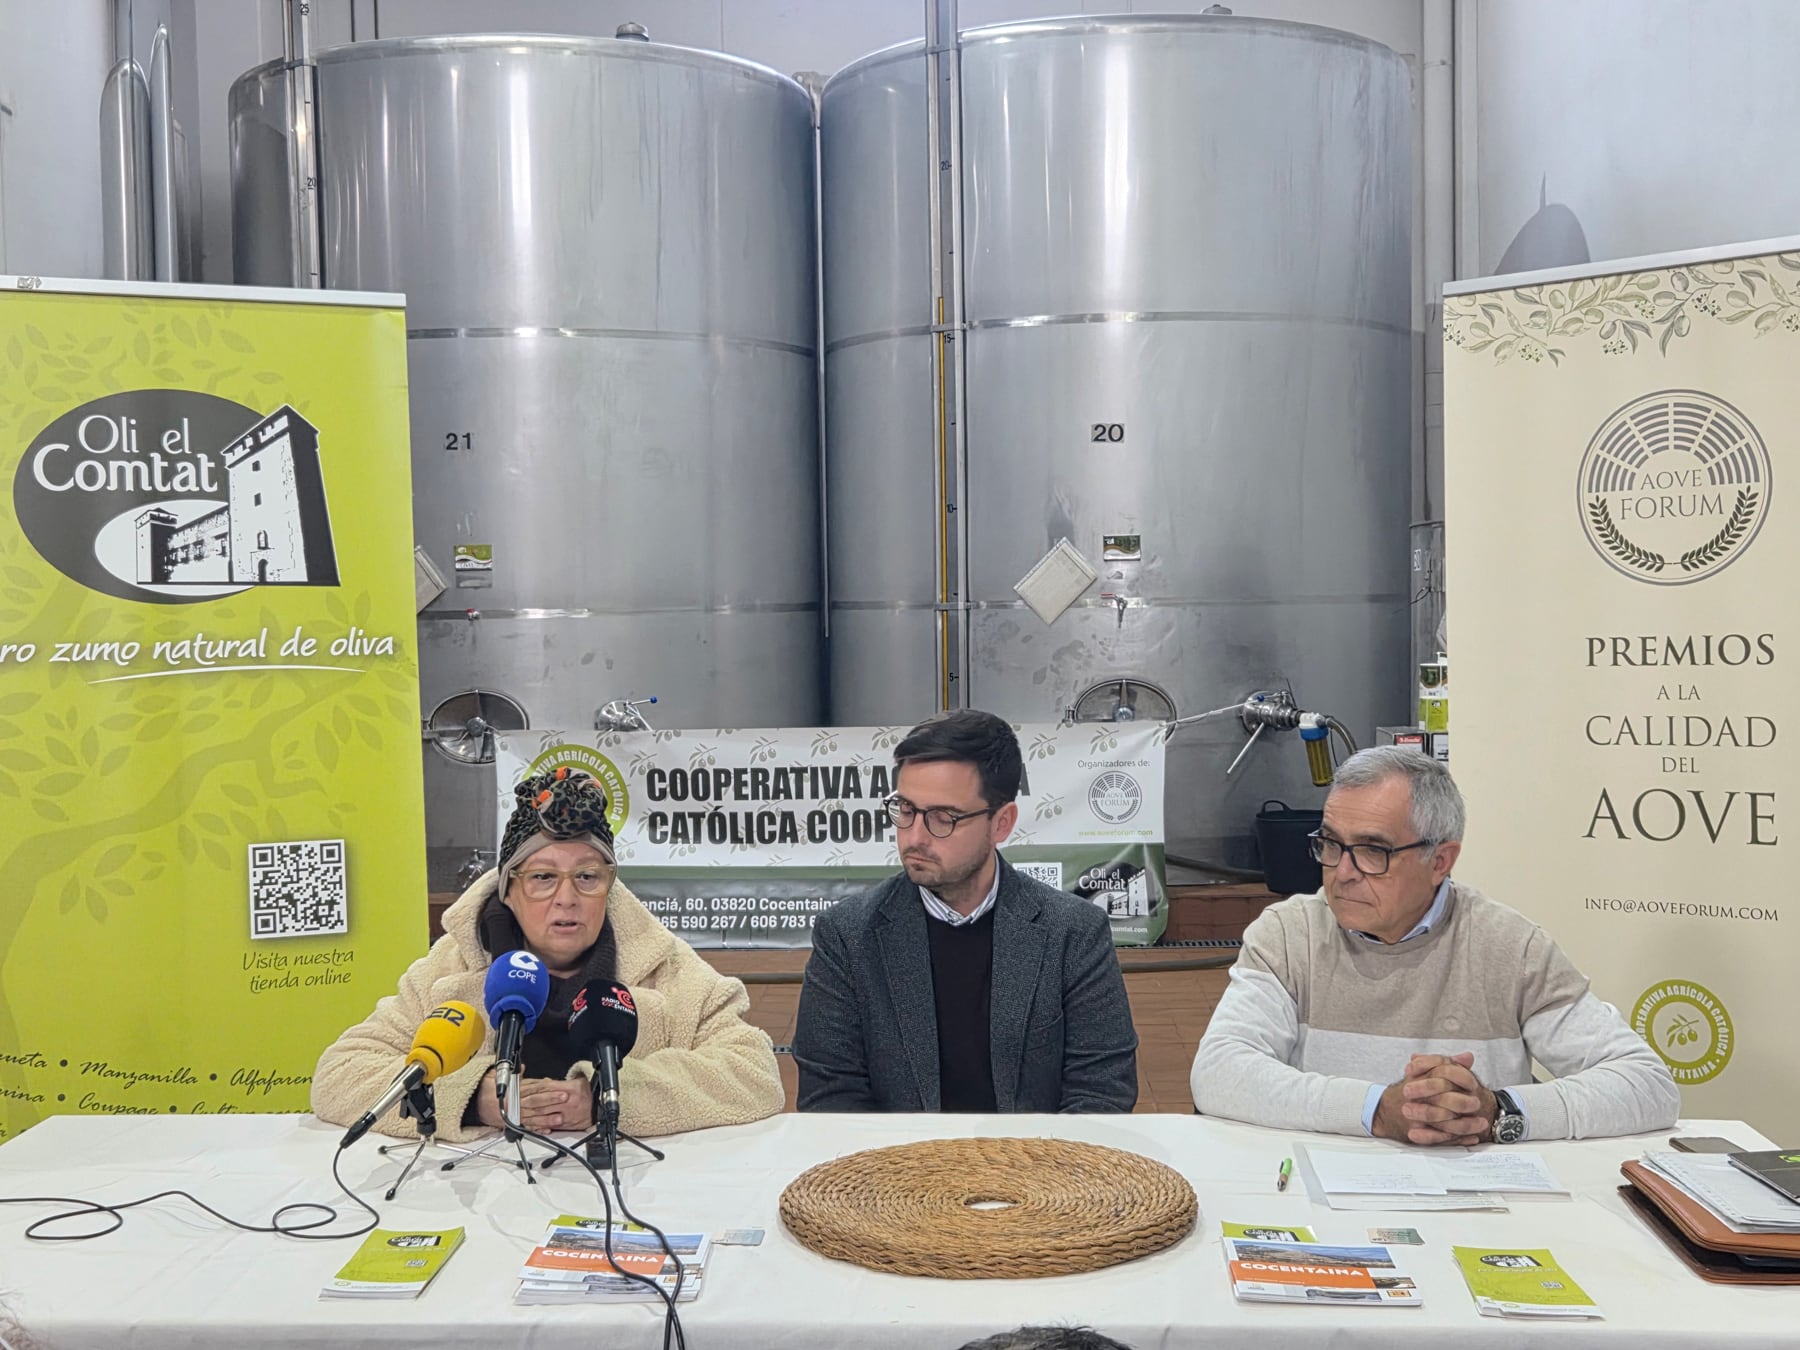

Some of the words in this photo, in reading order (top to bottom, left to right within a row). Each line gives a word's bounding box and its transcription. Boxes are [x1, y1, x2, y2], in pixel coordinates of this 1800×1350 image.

[78, 415, 140, 454] Oli
[162, 417, 191, 454] el
[445, 432, 472, 450] 21
[1093, 424, 1124, 442] 20
[33, 443, 218, 493] Comtat
[1640, 469, 1703, 491] AOVE
[1620, 493, 1725, 521] FORUM
[49, 640, 140, 666] zumo
[153, 627, 268, 665] natural
[280, 626, 318, 657] de
[330, 627, 395, 656] oliva
[1585, 633, 1776, 667] PREMIOS
[1656, 685, 1670, 700] A
[1678, 684, 1702, 701] LA
[1585, 714, 1777, 748] CALIDAD
[557, 750, 607, 774] AGRÍCOLA
[1077, 759, 1136, 770] Organizadores
[1661, 756, 1700, 774] DEL
[646, 765, 863, 802] COOPERATIVA
[648, 805, 800, 844] CATÓLICA
[806, 809, 896, 844] COOP.
[1581, 787, 1779, 846] AOVE
[1079, 875, 1126, 890] Comtat
[1090, 867, 1106, 879] Oli
[1111, 868, 1120, 880] el
[711, 898, 756, 911] 03820
[1584, 897, 1779, 921] INFO@AOVEFORUM.COM
[681, 916, 708, 929] 590
[711, 916, 737, 929] 267
[750, 916, 777, 928] 606
[780, 916, 806, 928] 783
[242, 951, 288, 971] Visita
[293, 948, 354, 966] nuestra
[250, 970, 299, 994] tienda
[304, 967, 351, 986] online
[508, 969, 537, 984] COPE
[80, 1061, 199, 1090] Manzanilla
[1240, 1262, 1364, 1277] COCENTAINA
